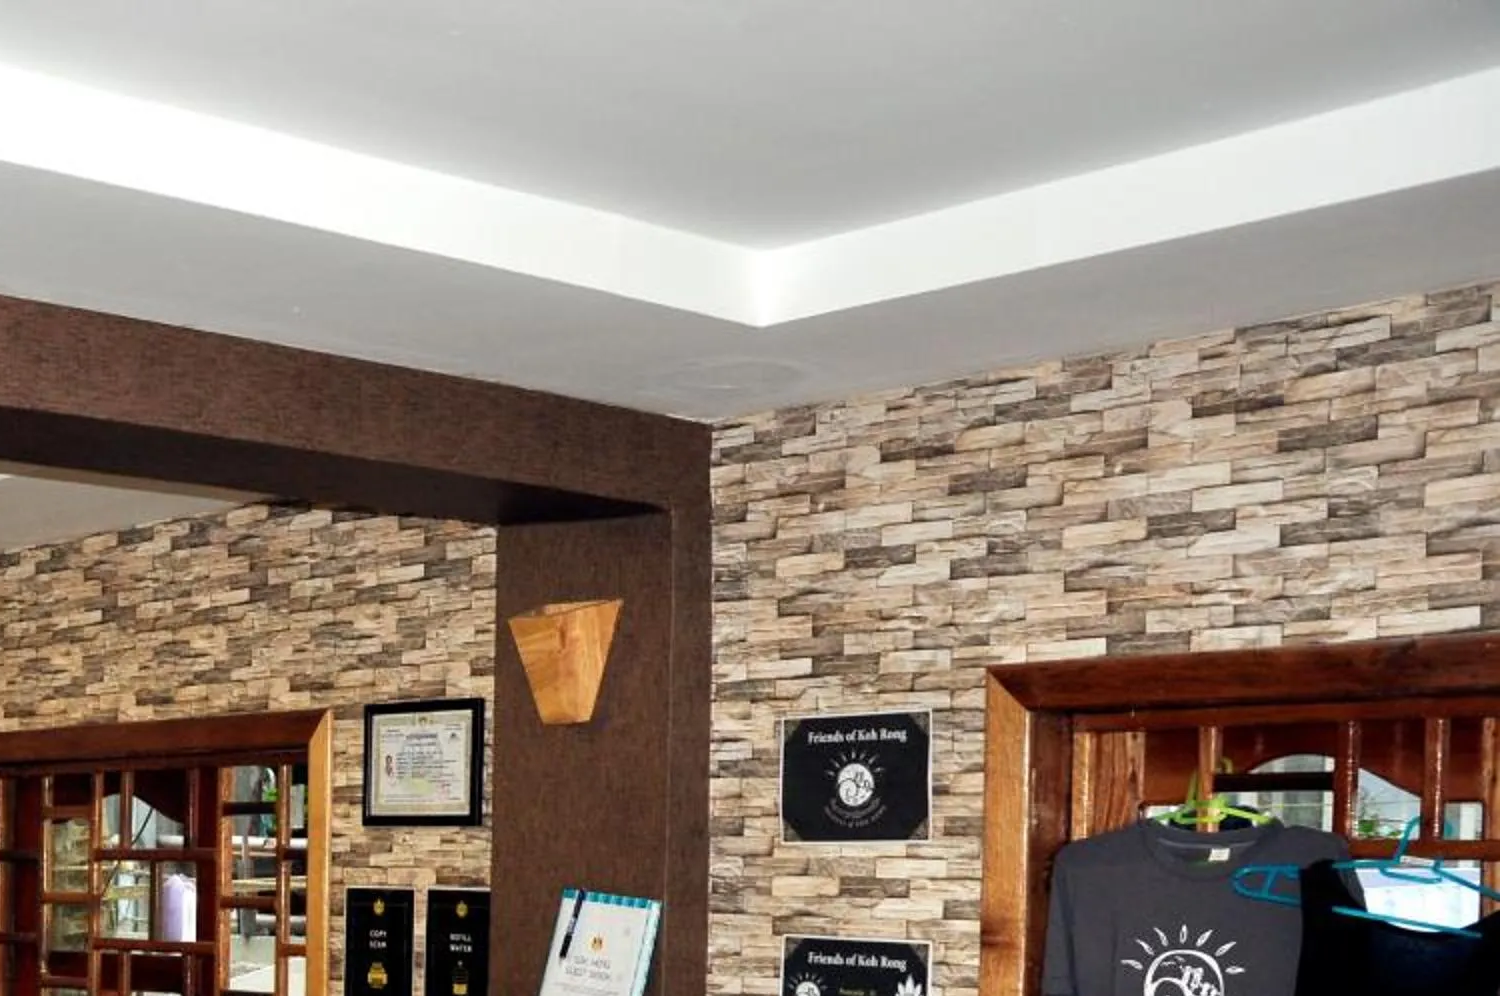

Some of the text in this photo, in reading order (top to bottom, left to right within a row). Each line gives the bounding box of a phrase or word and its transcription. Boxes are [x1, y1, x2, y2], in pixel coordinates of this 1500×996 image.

[807, 728, 908, 745] Friends of Koh Rong
[807, 951, 908, 972] Friends of Koh Rong
